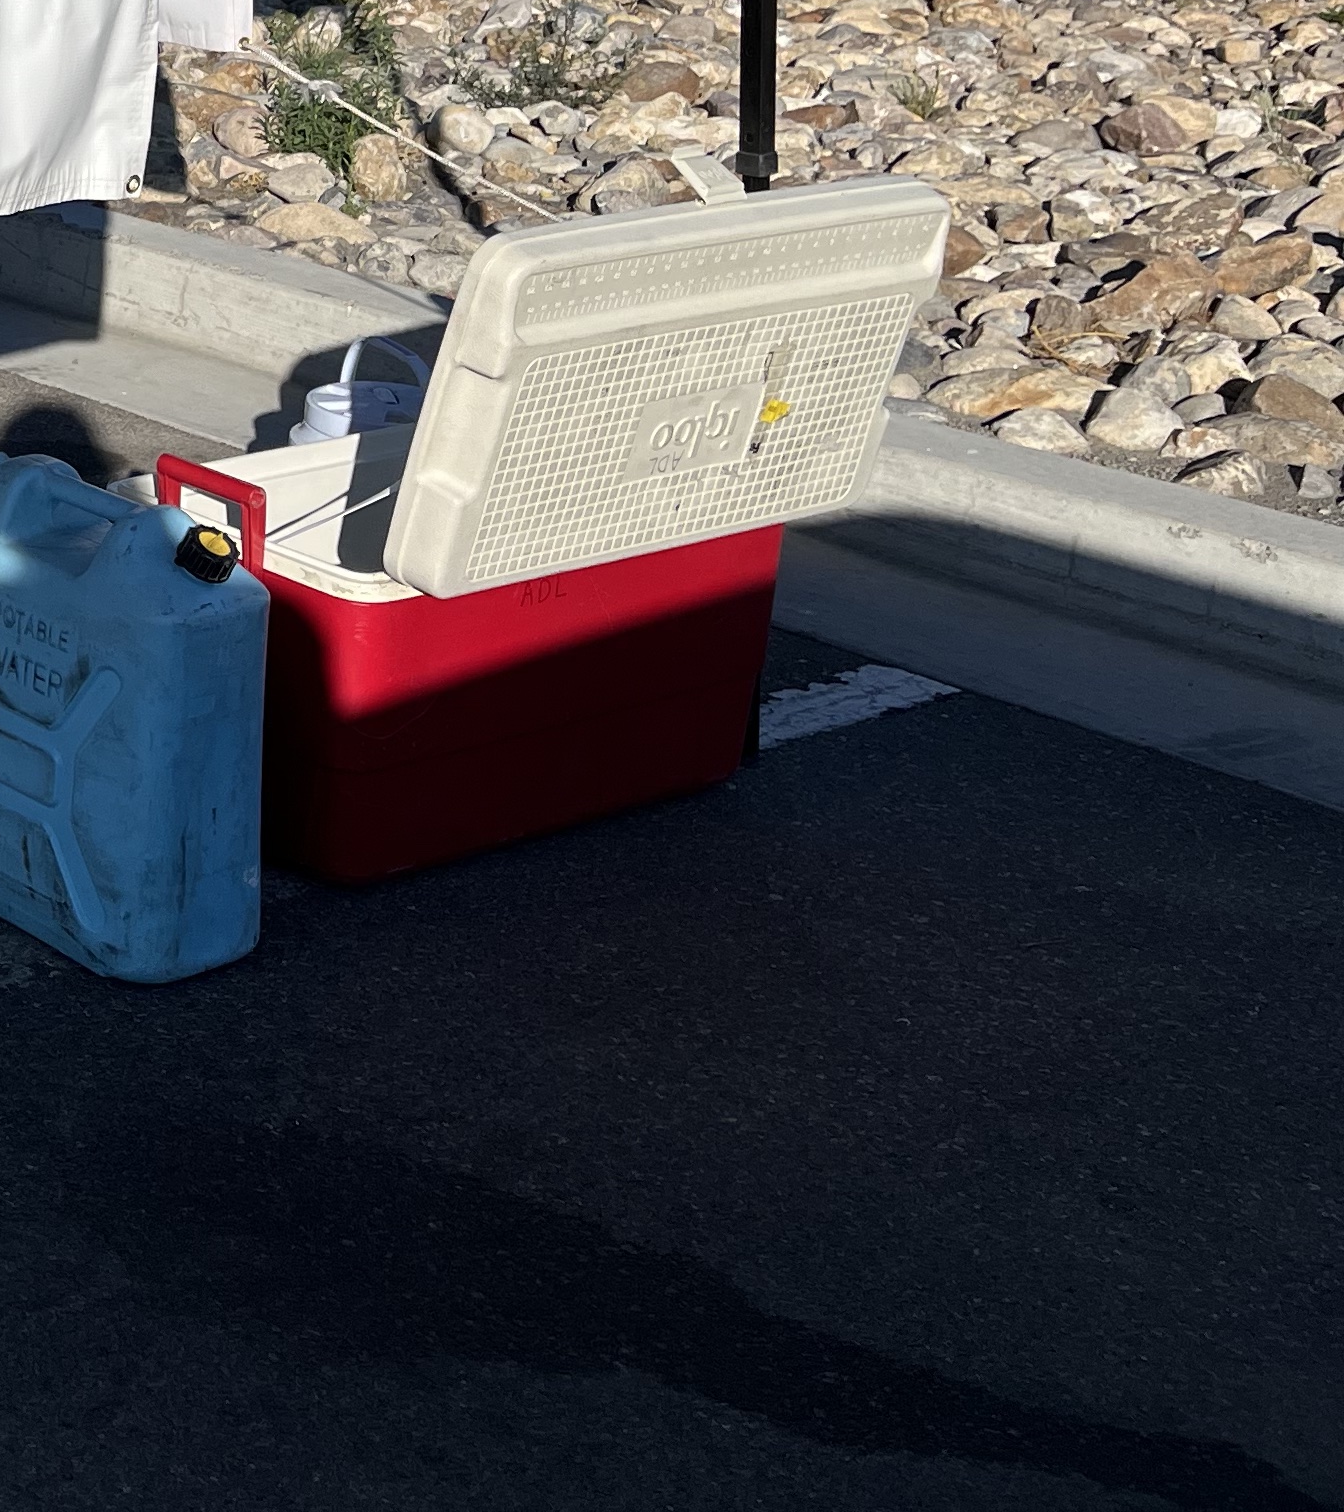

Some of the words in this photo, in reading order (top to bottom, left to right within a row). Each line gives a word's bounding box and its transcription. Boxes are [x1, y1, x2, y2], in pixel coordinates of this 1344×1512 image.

[649, 399, 741, 459] igloo
[648, 449, 686, 475] ADL
[519, 574, 568, 608] ADL
